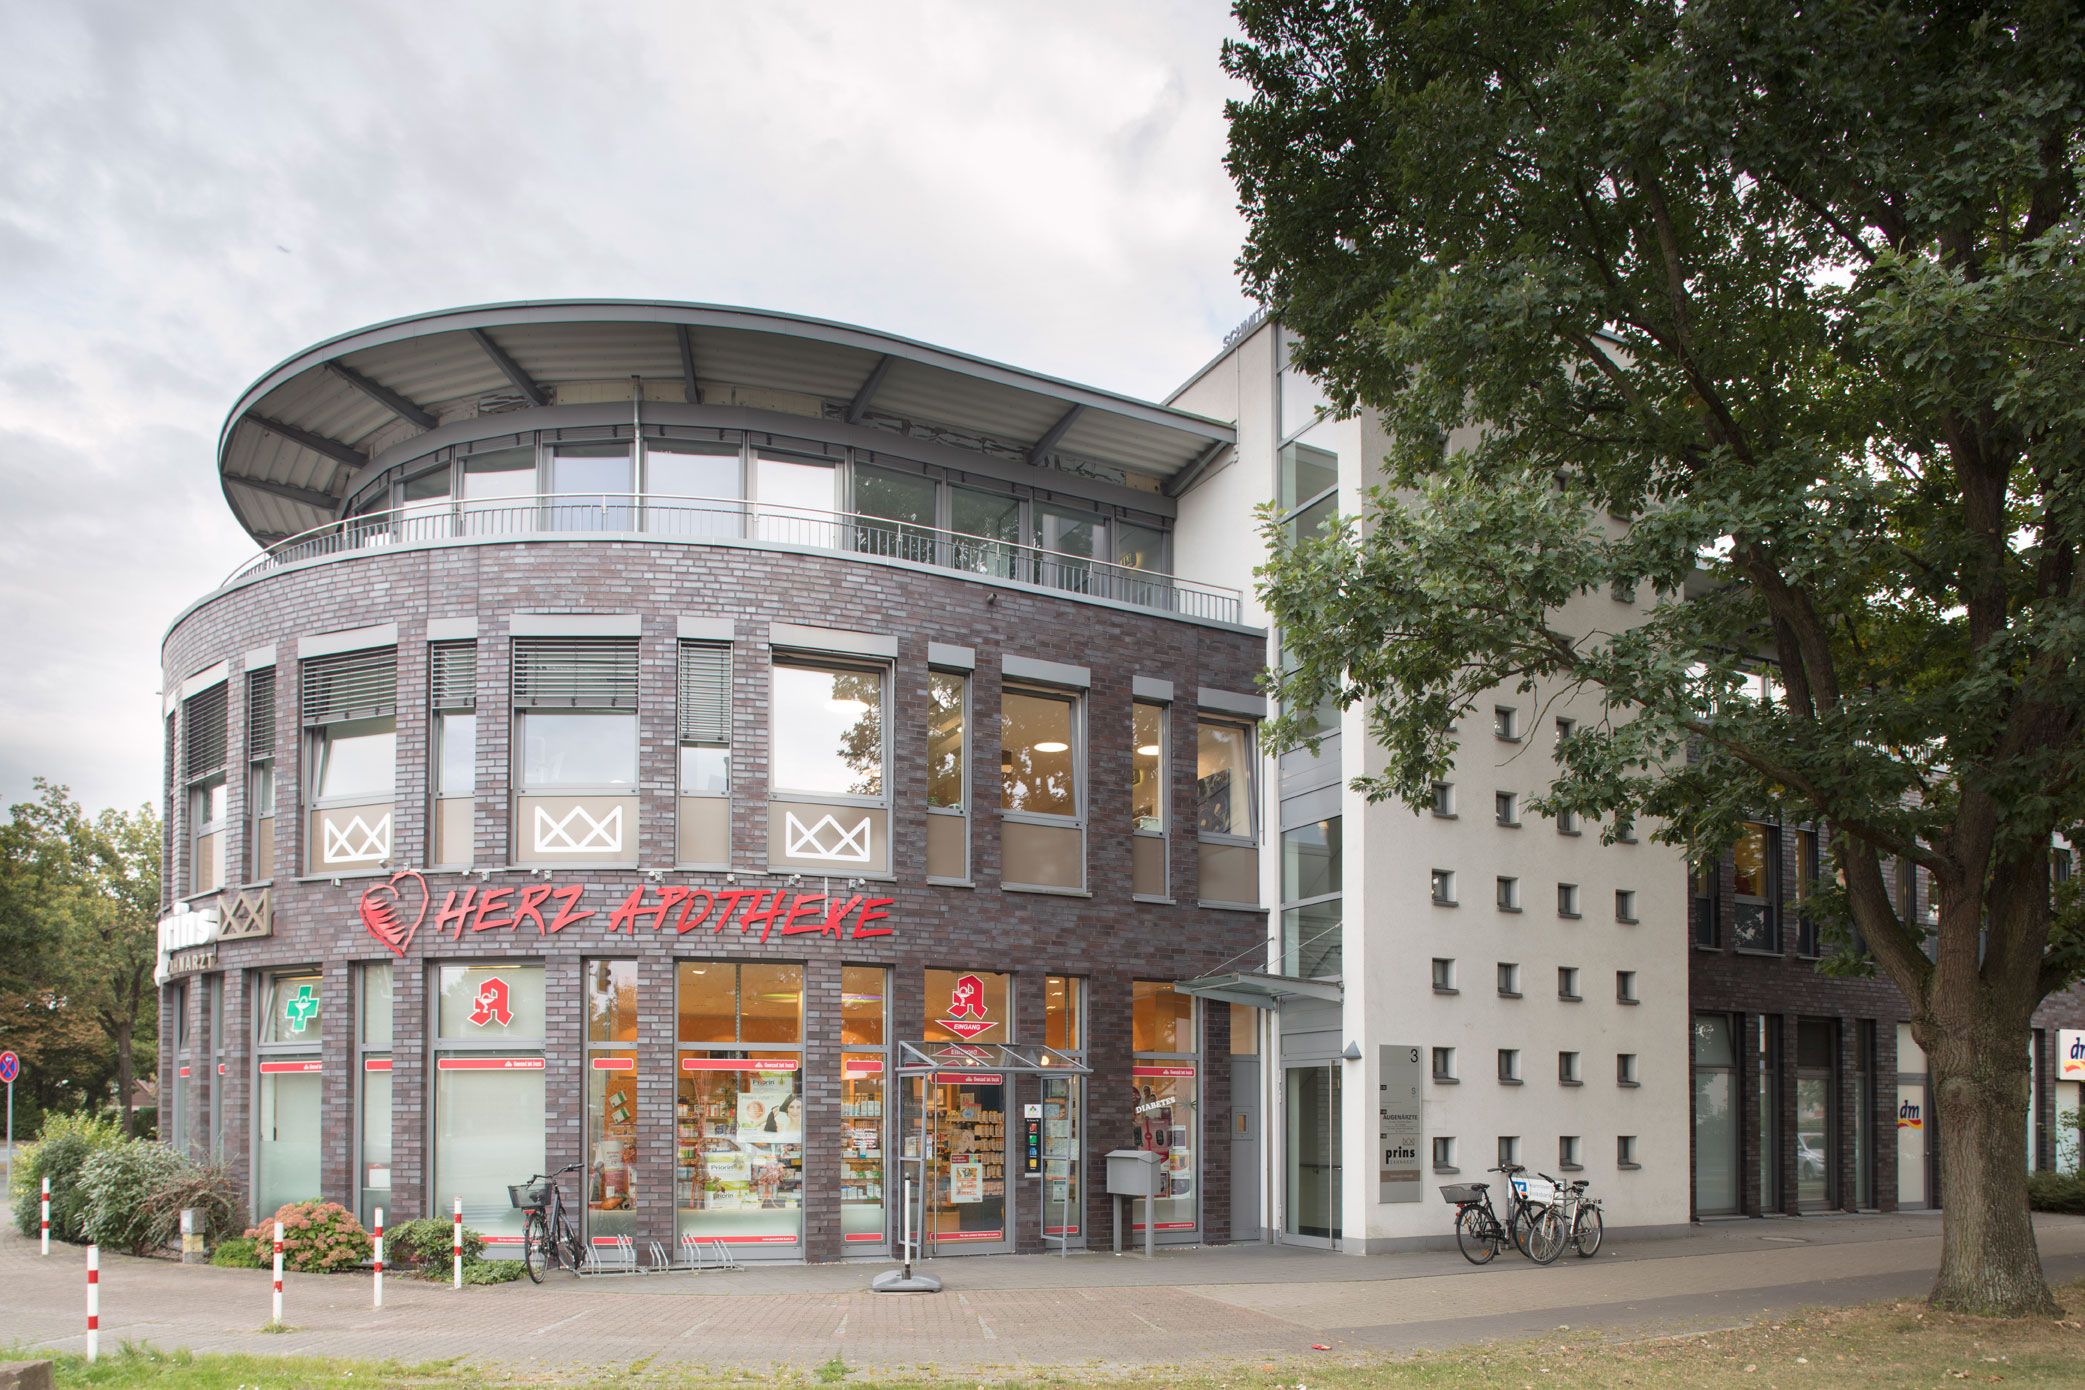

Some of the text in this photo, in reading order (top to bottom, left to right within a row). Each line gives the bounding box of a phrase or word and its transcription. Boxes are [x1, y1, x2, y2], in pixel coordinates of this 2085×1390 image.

[434, 884, 895, 944] HERZ APOTHEKE
[953, 1023, 981, 1031] EINGANG
[1410, 1048, 1419, 1063] 3
[1135, 1096, 1176, 1114] DIABETES
[1900, 1100, 1919, 1118] dm
[1383, 1113, 1418, 1121] AUGENÄRZTE
[1386, 1146, 1415, 1164] prins
